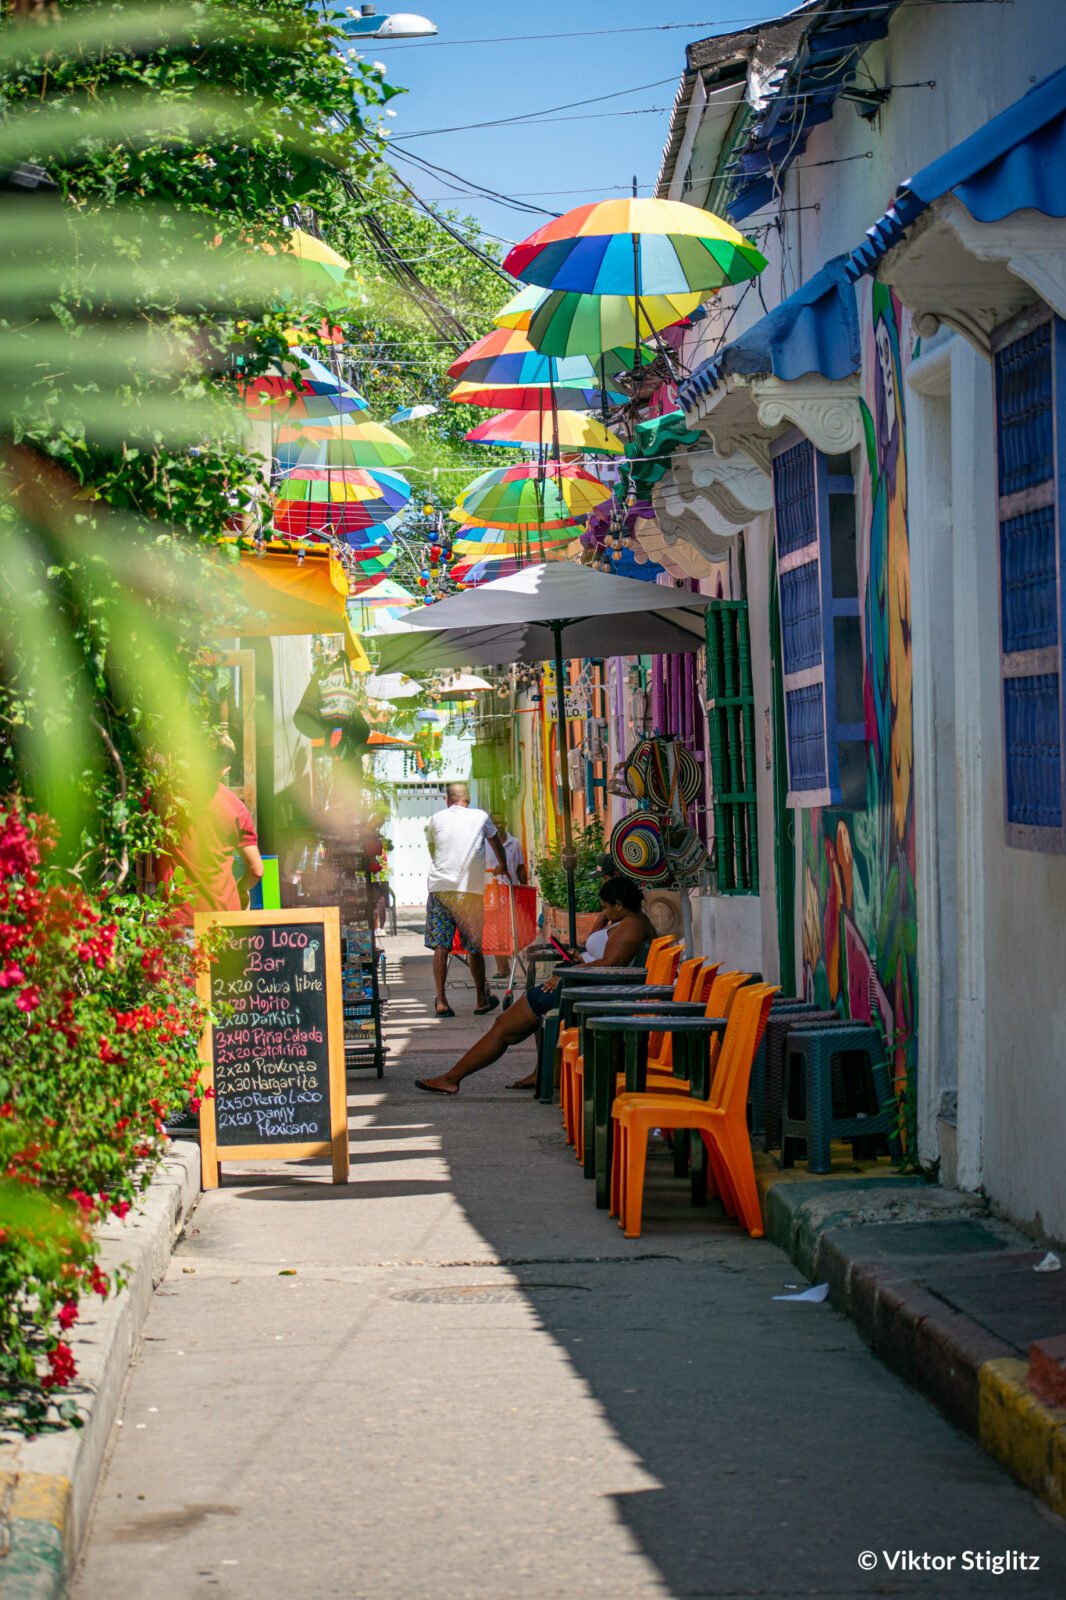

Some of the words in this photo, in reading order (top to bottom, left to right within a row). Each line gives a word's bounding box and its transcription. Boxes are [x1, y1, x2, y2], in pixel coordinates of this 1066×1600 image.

[551, 708, 582, 718] HLO.
[243, 952, 285, 976] Bar
[256, 977, 290, 993] Cuba
[251, 1073, 319, 1095] Margarita
[252, 1092, 287, 1106] Perro
[253, 1106, 296, 1124] Danny
[258, 1119, 318, 1136] Mexicano
